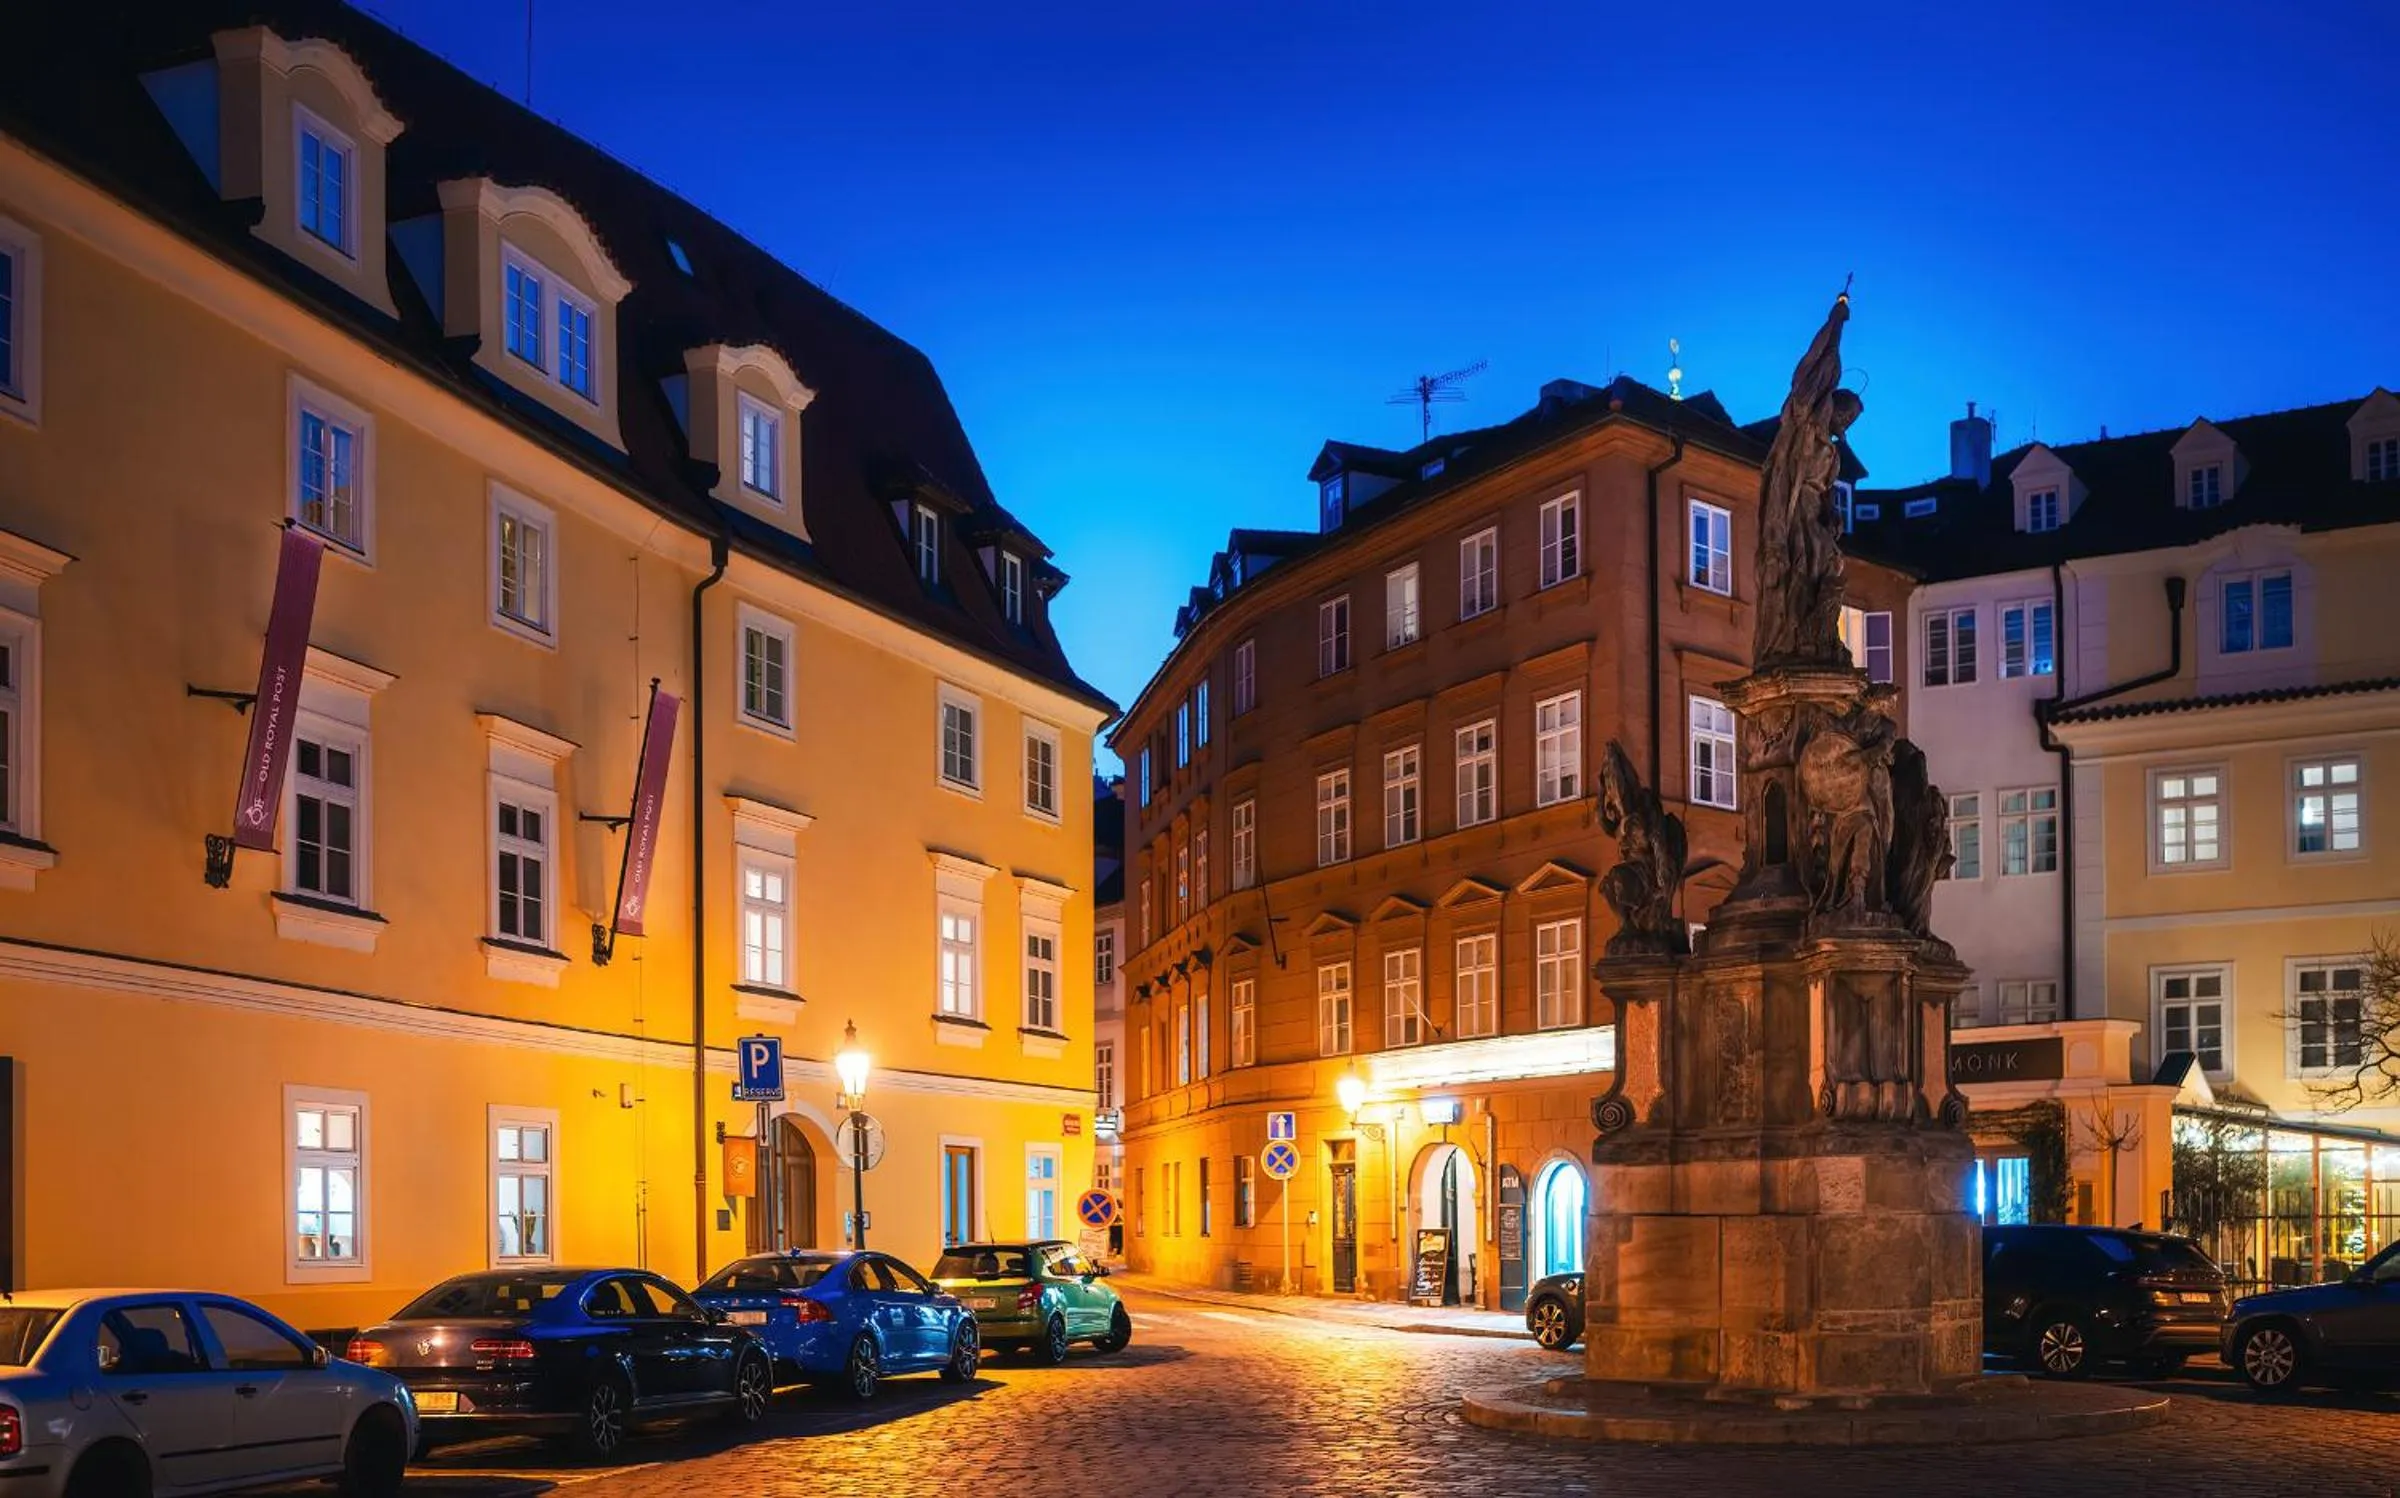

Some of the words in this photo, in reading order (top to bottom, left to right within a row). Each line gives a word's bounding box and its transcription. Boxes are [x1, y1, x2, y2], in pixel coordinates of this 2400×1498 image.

[259, 753, 271, 782] OLD
[265, 706, 281, 750] ROYAL
[273, 666, 288, 702] POST
[644, 794, 654, 821] POST
[751, 1043, 769, 1079] P
[1502, 1176, 1519, 1188] ATM
